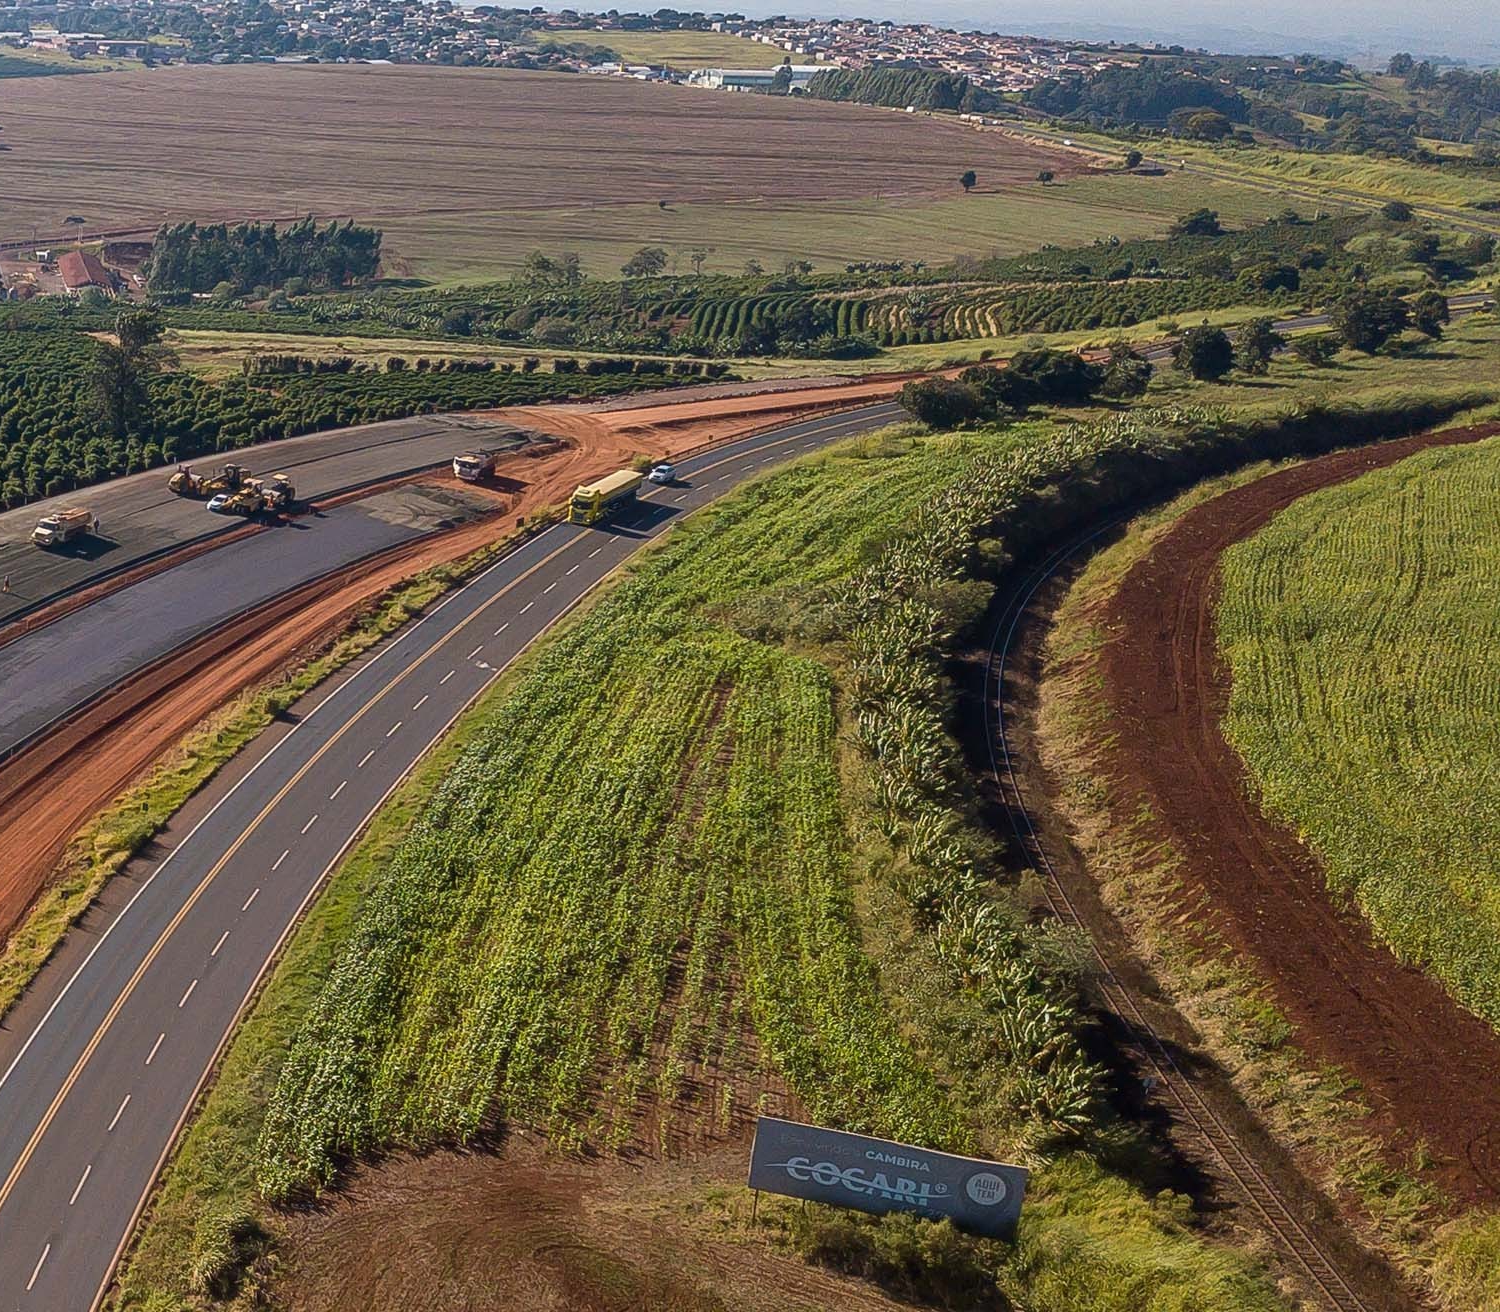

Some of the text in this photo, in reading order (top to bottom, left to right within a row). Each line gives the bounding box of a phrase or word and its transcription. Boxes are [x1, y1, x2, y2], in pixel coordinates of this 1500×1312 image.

[865, 1150, 931, 1172] CAMBIRA
[786, 1156, 931, 1206] COCARI
[975, 1178, 1000, 1193] AQUI
